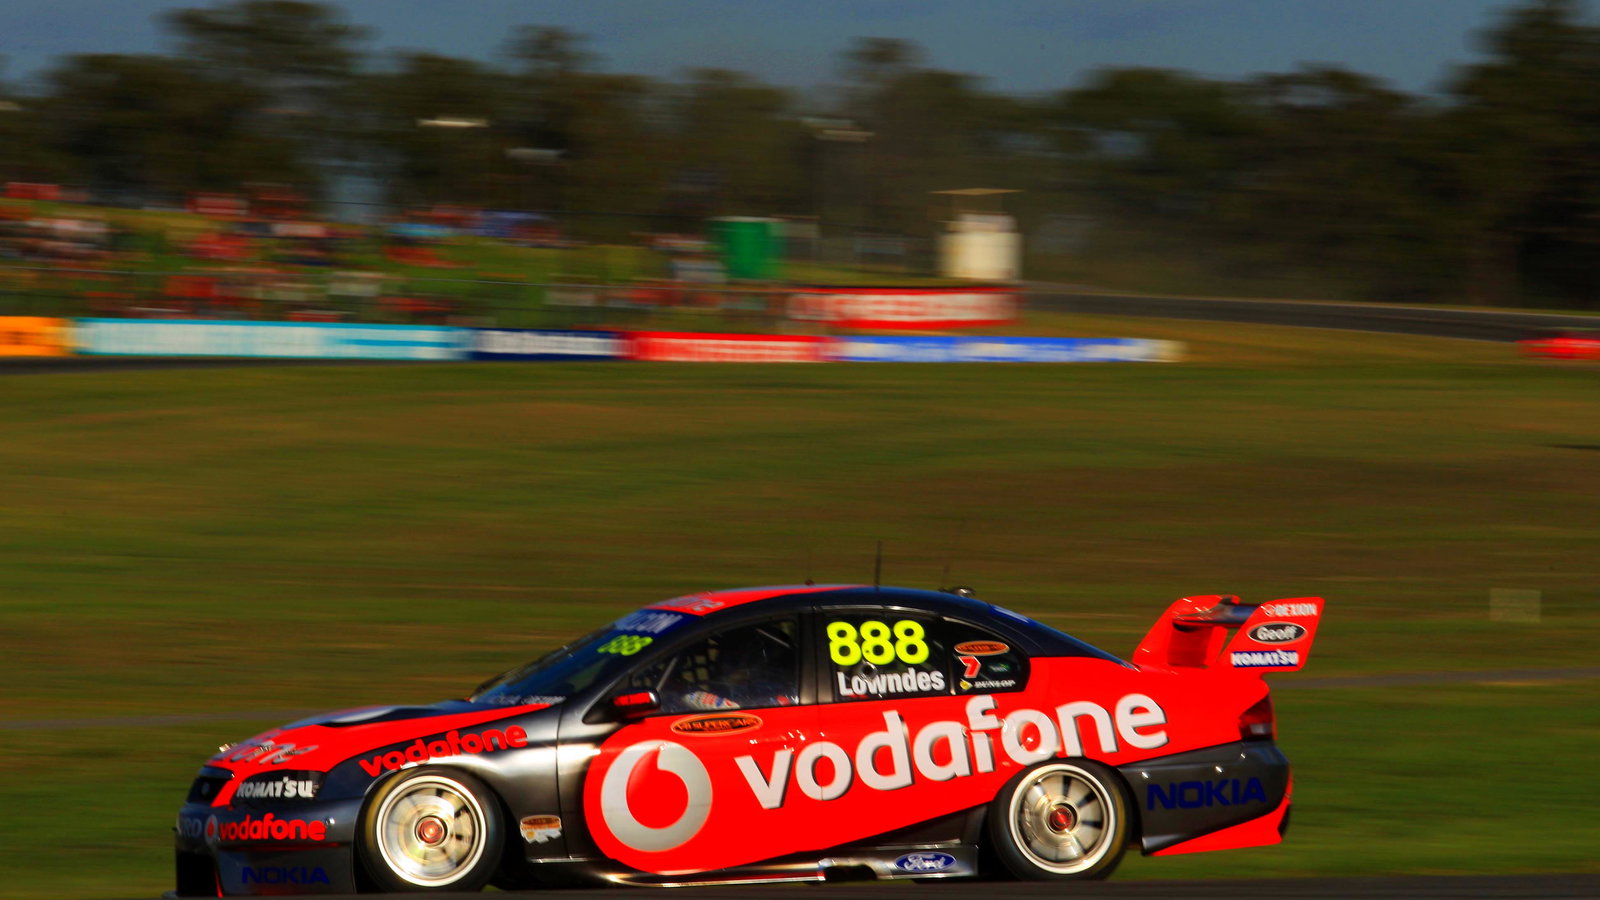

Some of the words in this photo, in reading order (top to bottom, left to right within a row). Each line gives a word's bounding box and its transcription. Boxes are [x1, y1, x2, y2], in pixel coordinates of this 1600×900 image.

[827, 620, 930, 666] 888
[1257, 625, 1297, 641] Geoff
[957, 655, 982, 679] 7
[1231, 649, 1299, 667] KOMATSU
[836, 667, 946, 696] Lowndes
[358, 724, 529, 778] vodafone
[734, 694, 1168, 809] vodafone
[236, 775, 315, 799] KOMATSU
[1146, 776, 1267, 811] NOKIA
[218, 812, 327, 841] vodafone
[903, 853, 946, 871] Ford
[240, 866, 330, 885] NOKIA
